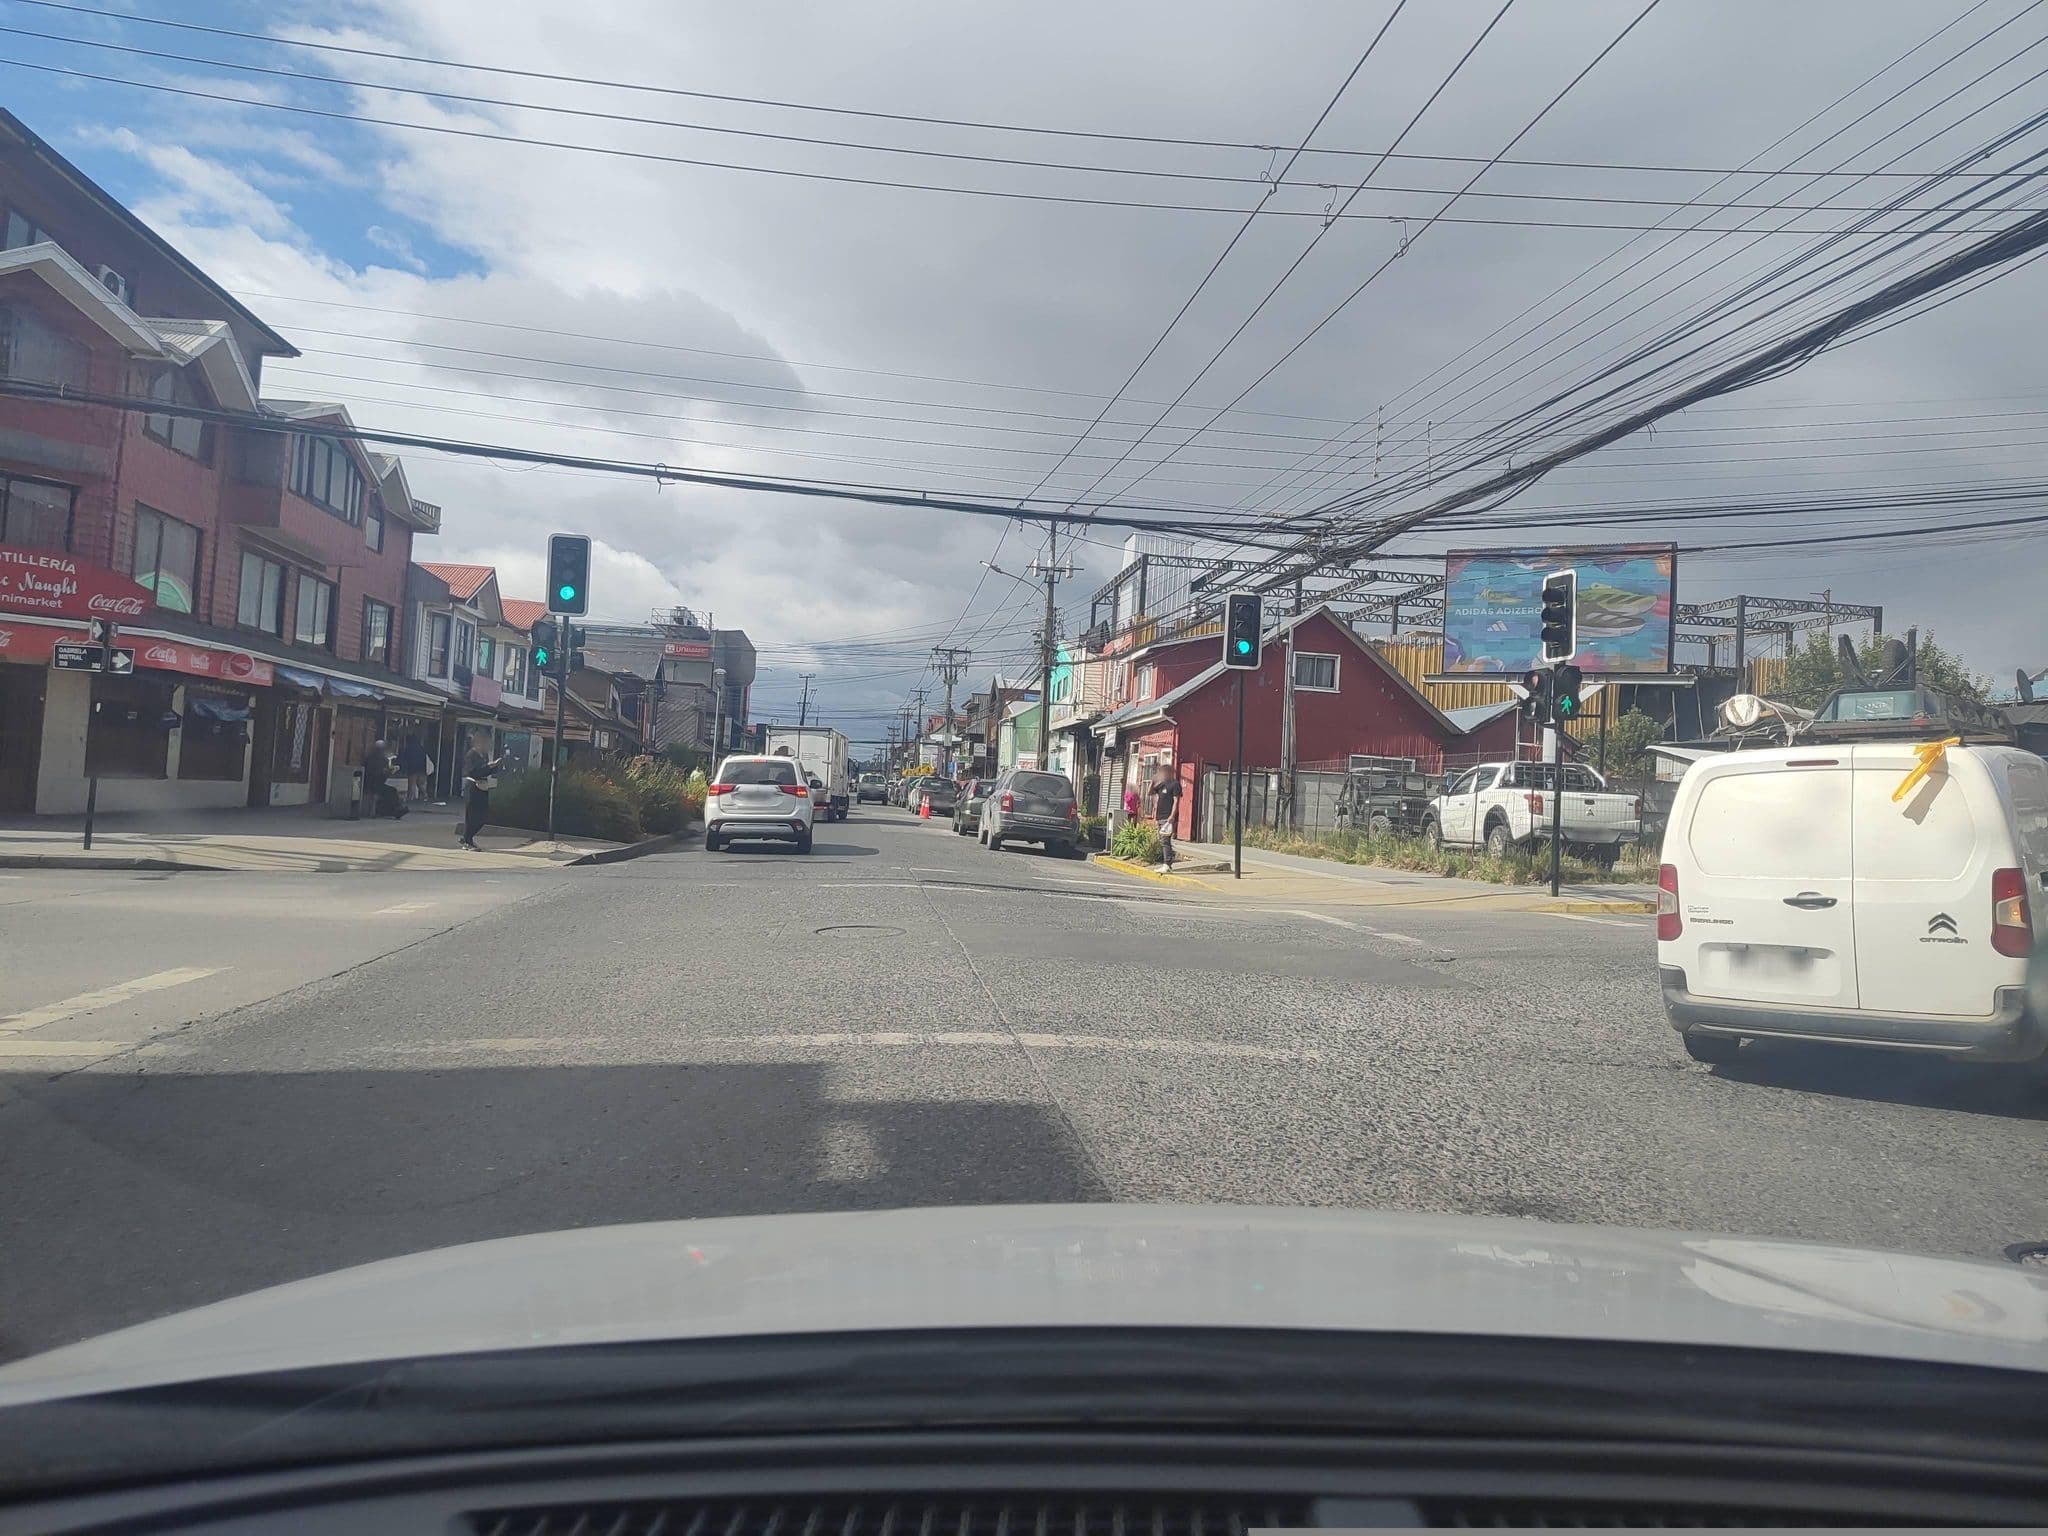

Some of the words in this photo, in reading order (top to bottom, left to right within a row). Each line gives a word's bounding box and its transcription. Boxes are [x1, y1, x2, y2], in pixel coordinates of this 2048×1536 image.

[0, 551, 77, 575] TILLERÍA
[18, 571, 78, 598] Naught
[1454, 607, 1494, 616] ADIDAS
